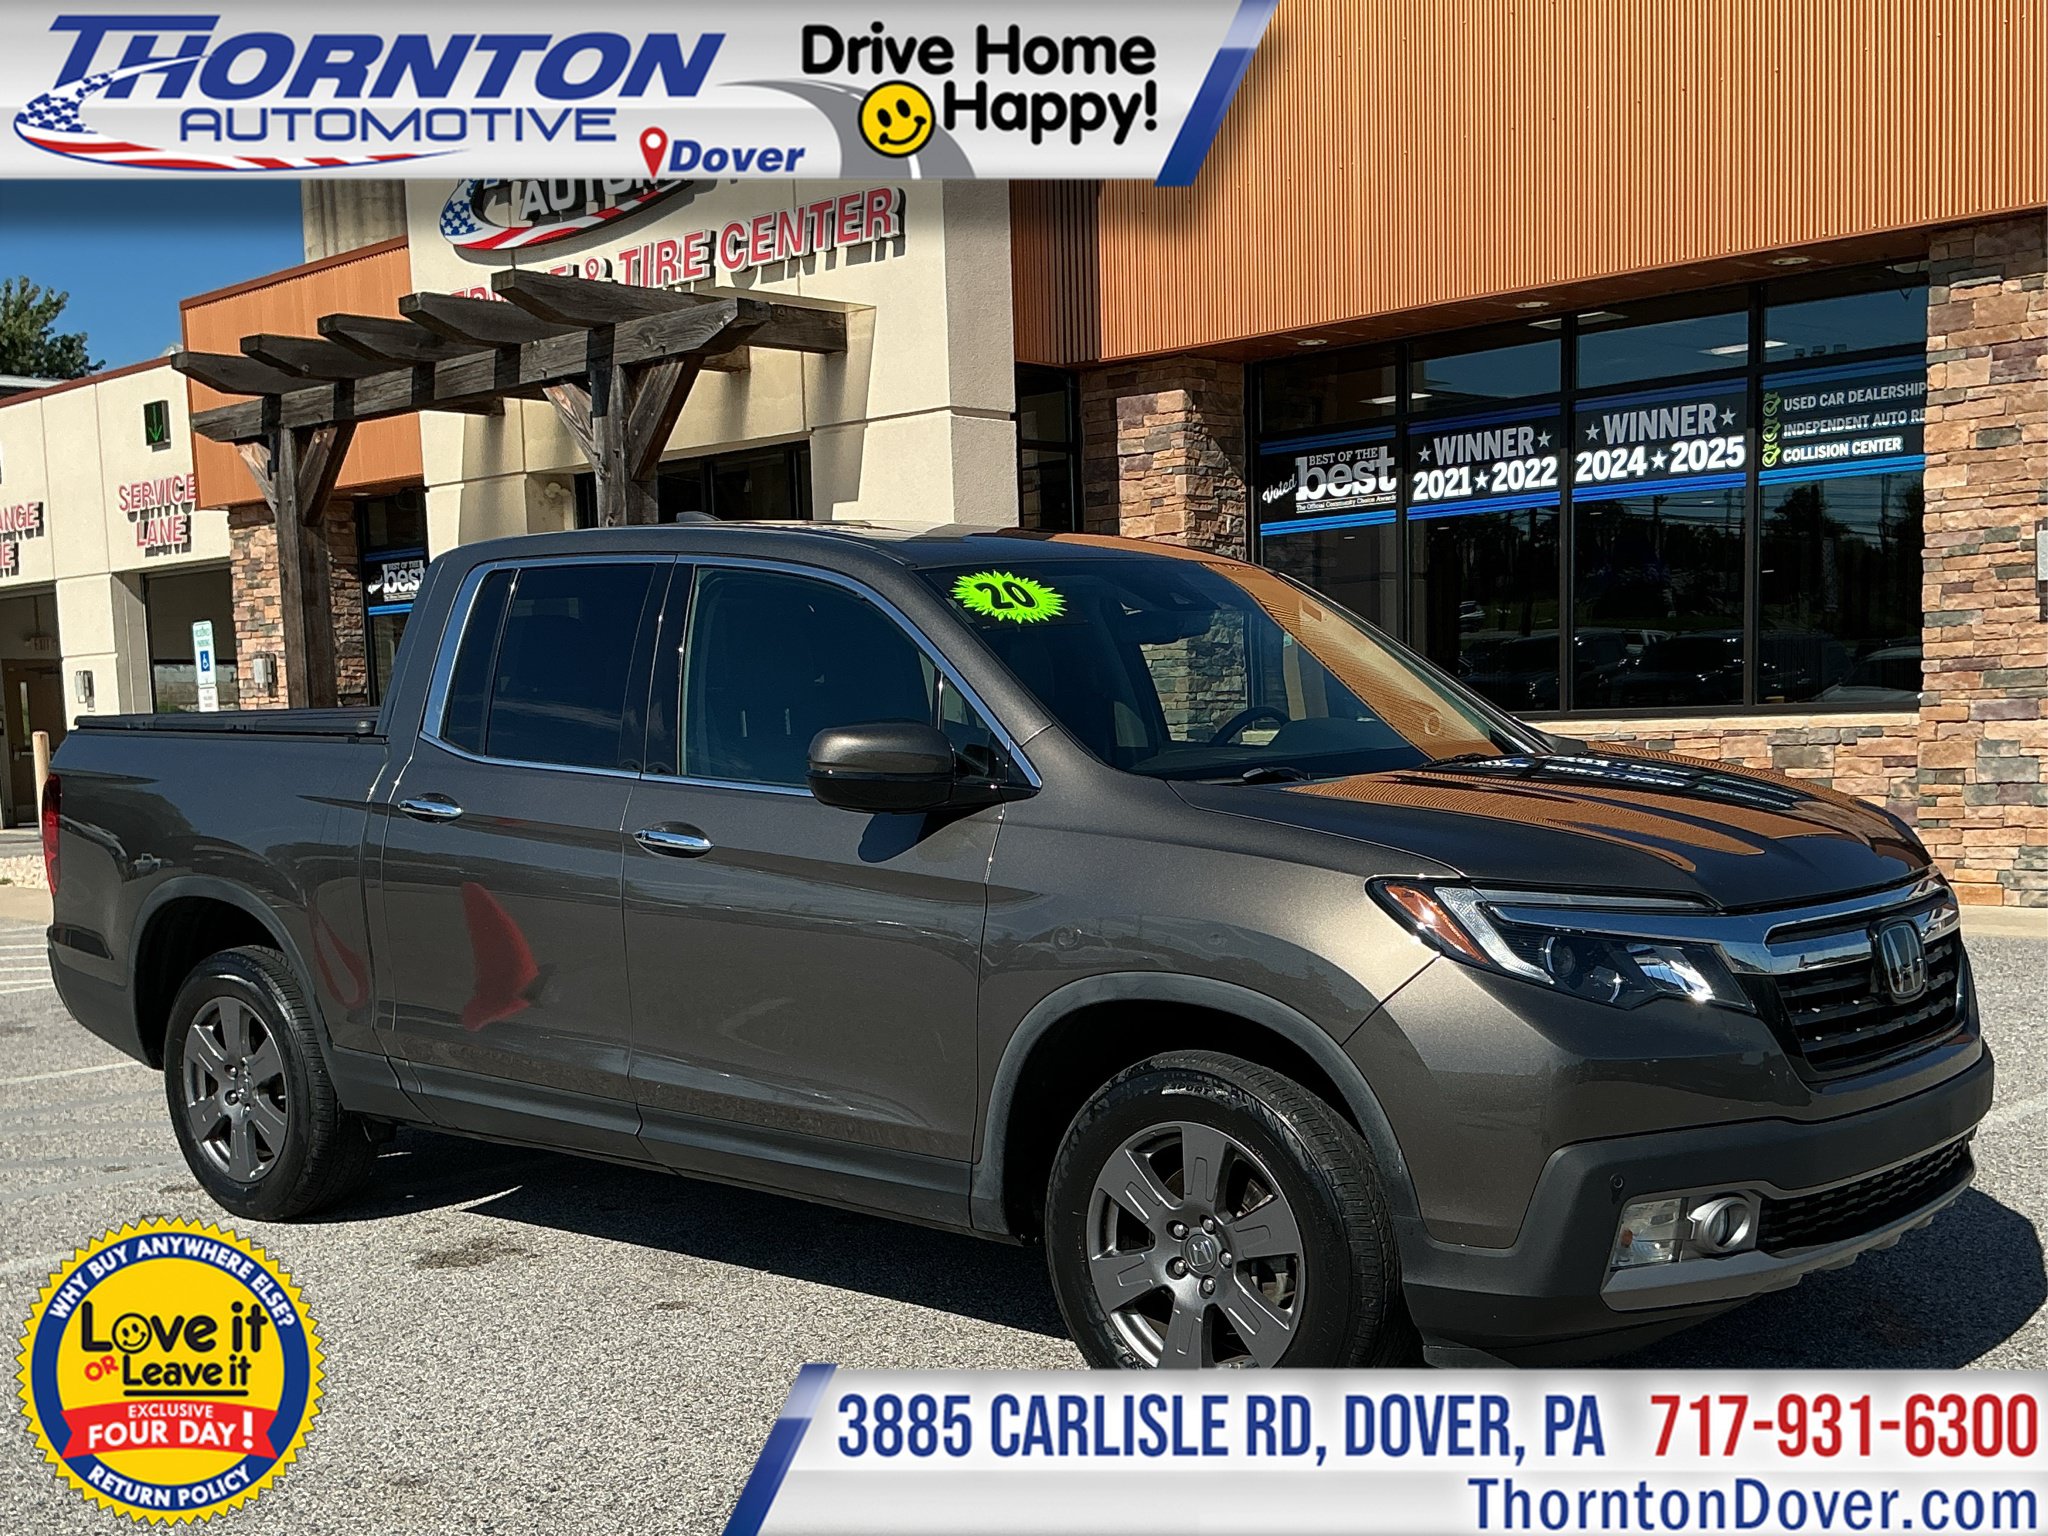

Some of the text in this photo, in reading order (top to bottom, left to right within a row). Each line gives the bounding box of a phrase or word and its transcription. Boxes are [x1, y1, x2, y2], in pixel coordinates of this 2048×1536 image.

[619, 230, 710, 289] TIRE
[718, 186, 901, 272] CENTER
[1784, 382, 1926, 412] USED CAR DEALERSHIP
[1603, 404, 1716, 444] WINNER
[1783, 414, 1869, 437] INDEPENDENT
[1873, 411, 1907, 426] AUTO
[1309, 447, 1378, 466] BEST OF THE
[1433, 426, 1535, 466] WINNER
[1575, 435, 1745, 483] 2024 2025
[1783, 443, 1848, 462] COLLISION
[1852, 437, 1901, 455] CENTER
[1262, 474, 1297, 503] Voted
[1295, 446, 1397, 501] best
[1412, 456, 1558, 500] 2021 2022
[119, 473, 196, 511] SERVICE
[137, 515, 184, 547] LANE
[974, 581, 1036, 609] 20
